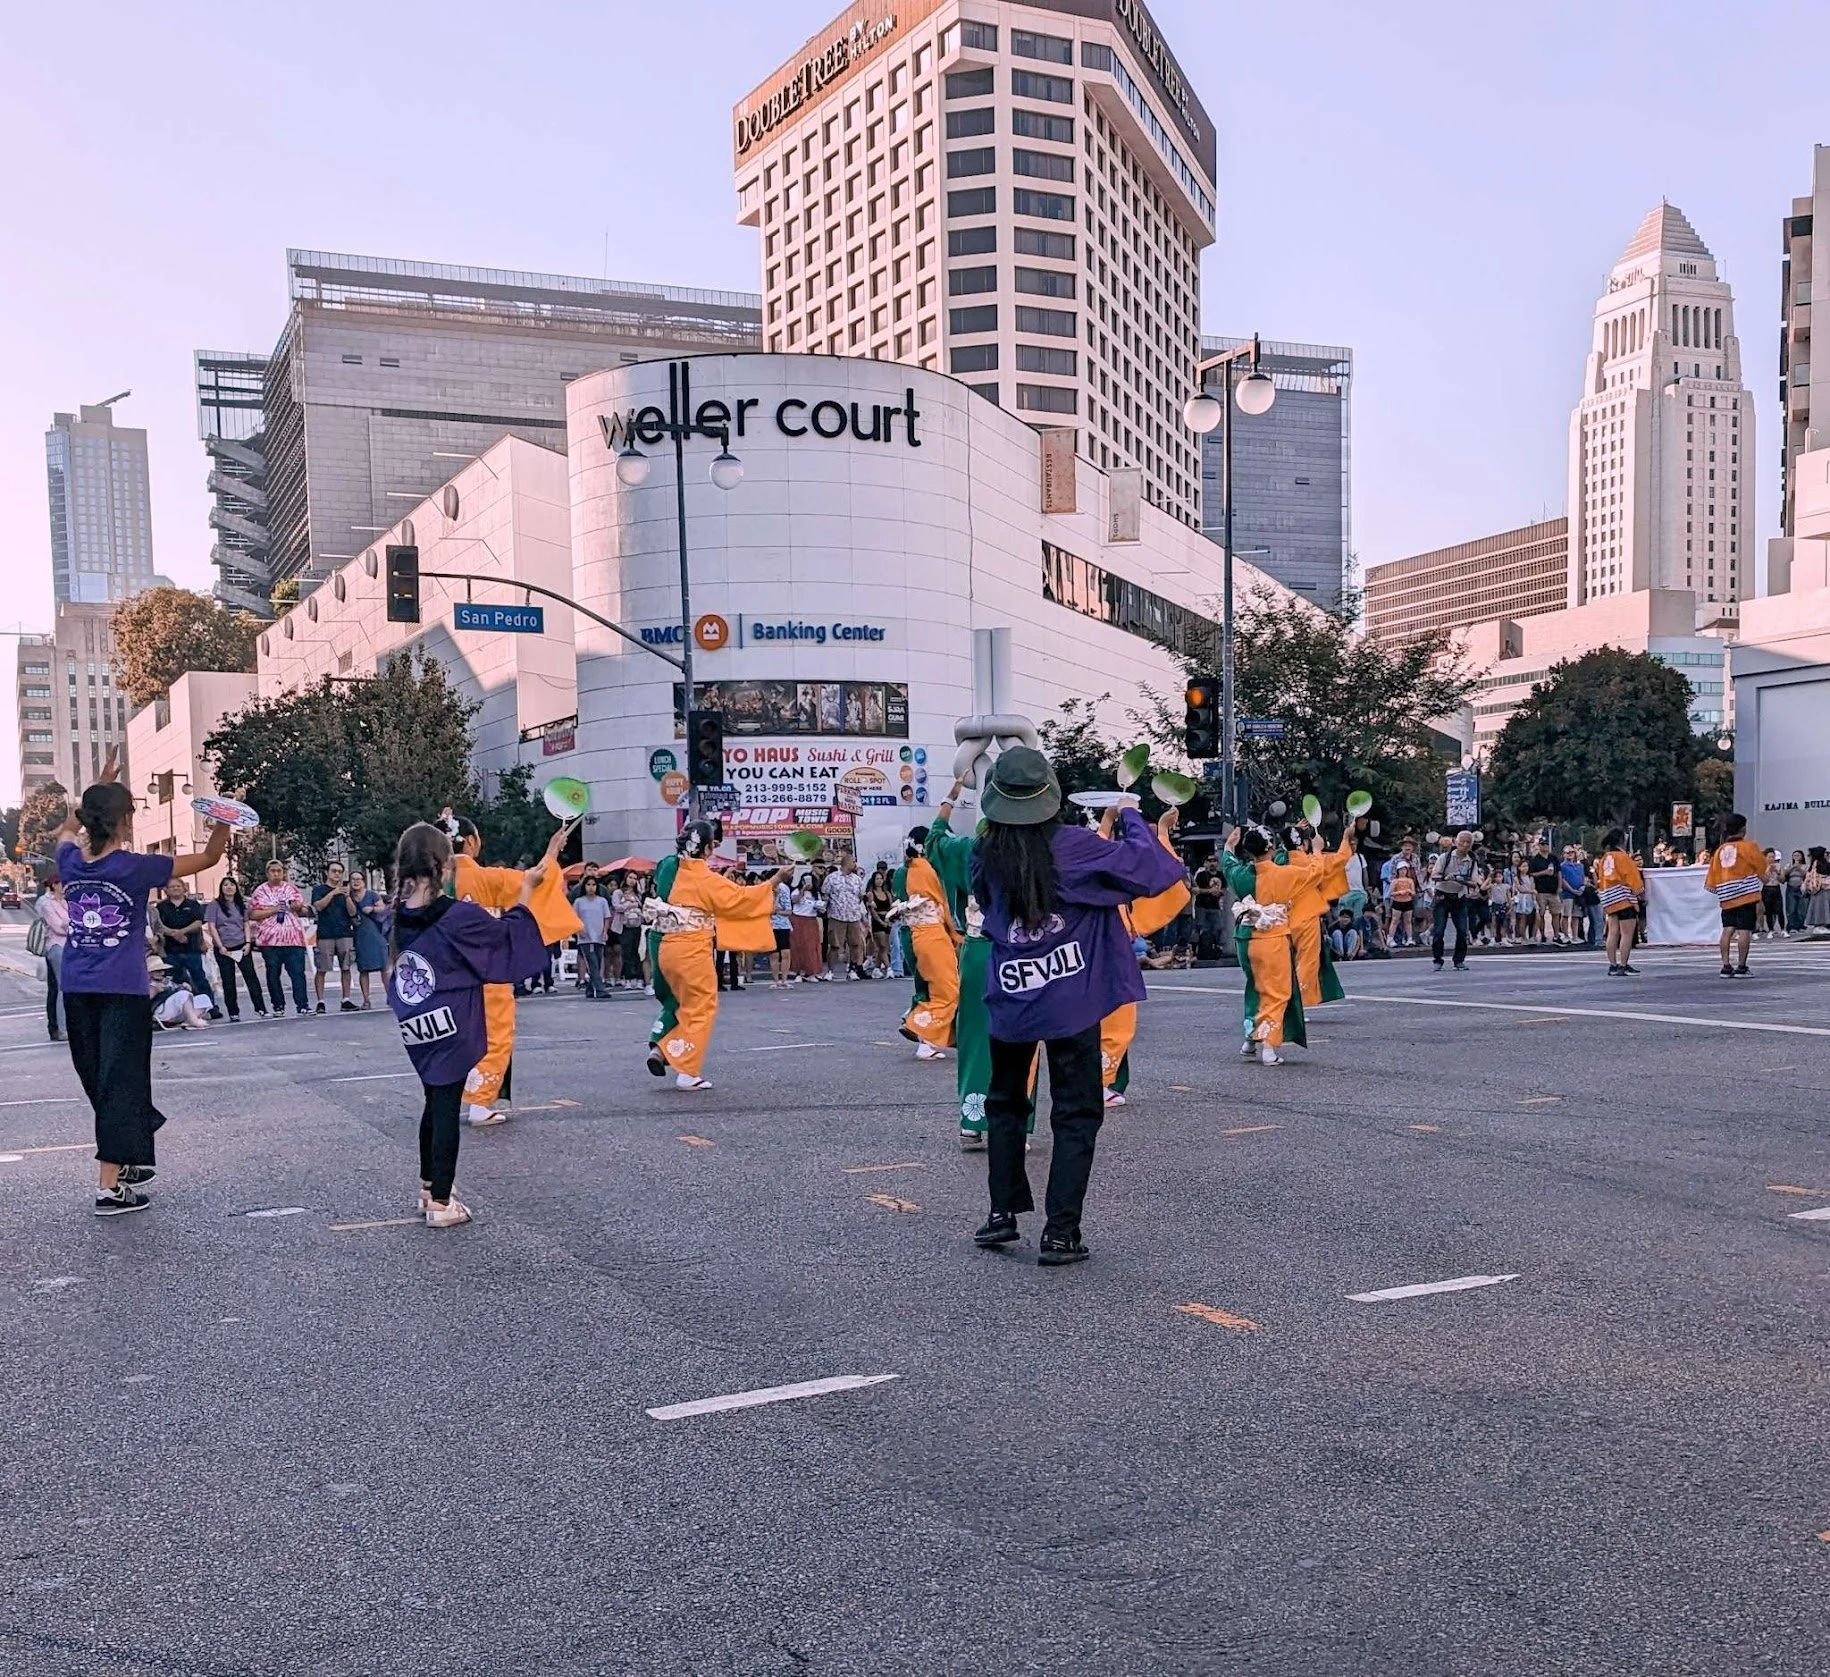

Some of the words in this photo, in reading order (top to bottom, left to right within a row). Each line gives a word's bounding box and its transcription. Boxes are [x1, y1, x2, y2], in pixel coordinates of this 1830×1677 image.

[849, 18, 868, 43] BY
[851, 14, 897, 60] HILTON
[735, 37, 850, 154] DOUBLETREE
[598, 361, 759, 449] weller
[776, 388, 921, 447] court
[461, 610, 489, 624] San
[495, 612, 537, 627] Pedro
[753, 621, 826, 643] Banking
[832, 623, 886, 641] Center
[754, 748, 799, 762] HAUS
[808, 748, 848, 762] Sushi
[851, 750, 862, 761] &
[866, 748, 894, 765] Grill
[726, 767, 763, 779] YOU
[769, 767, 804, 778] CAN
[810, 766, 839, 778] EAT
[745, 783, 827, 792] 213-999-5152
[745, 795, 827, 804] 213-266-8879
[1764, 802, 1799, 811] KAJIMA
[798, 816, 829, 824] TOWN
[1001, 944, 1082, 991] SFVJLI
